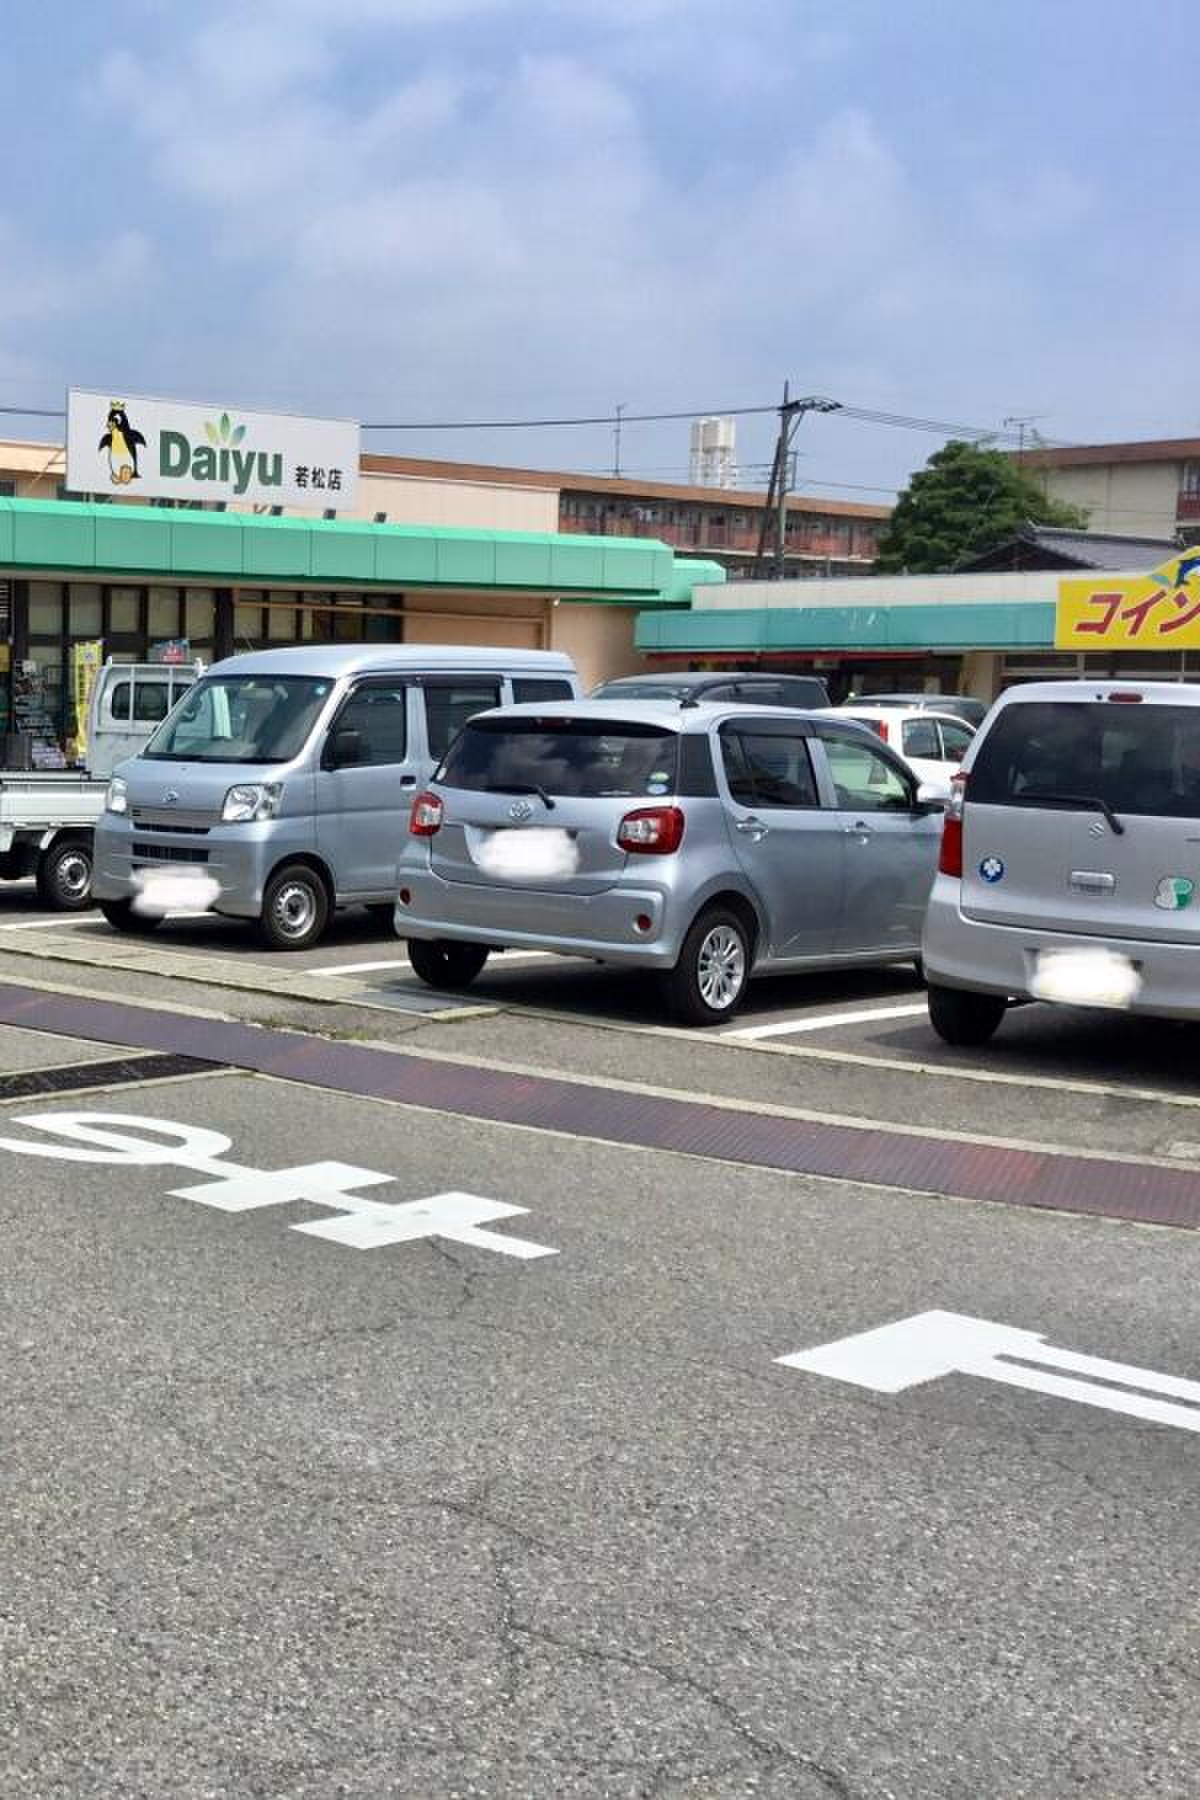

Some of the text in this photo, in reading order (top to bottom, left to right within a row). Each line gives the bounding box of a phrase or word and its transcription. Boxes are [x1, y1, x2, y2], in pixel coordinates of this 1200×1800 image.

[159, 429, 283, 494] Daiyu
[294, 466, 342, 491] 若松店
[1075, 590, 1200, 636] コイン
